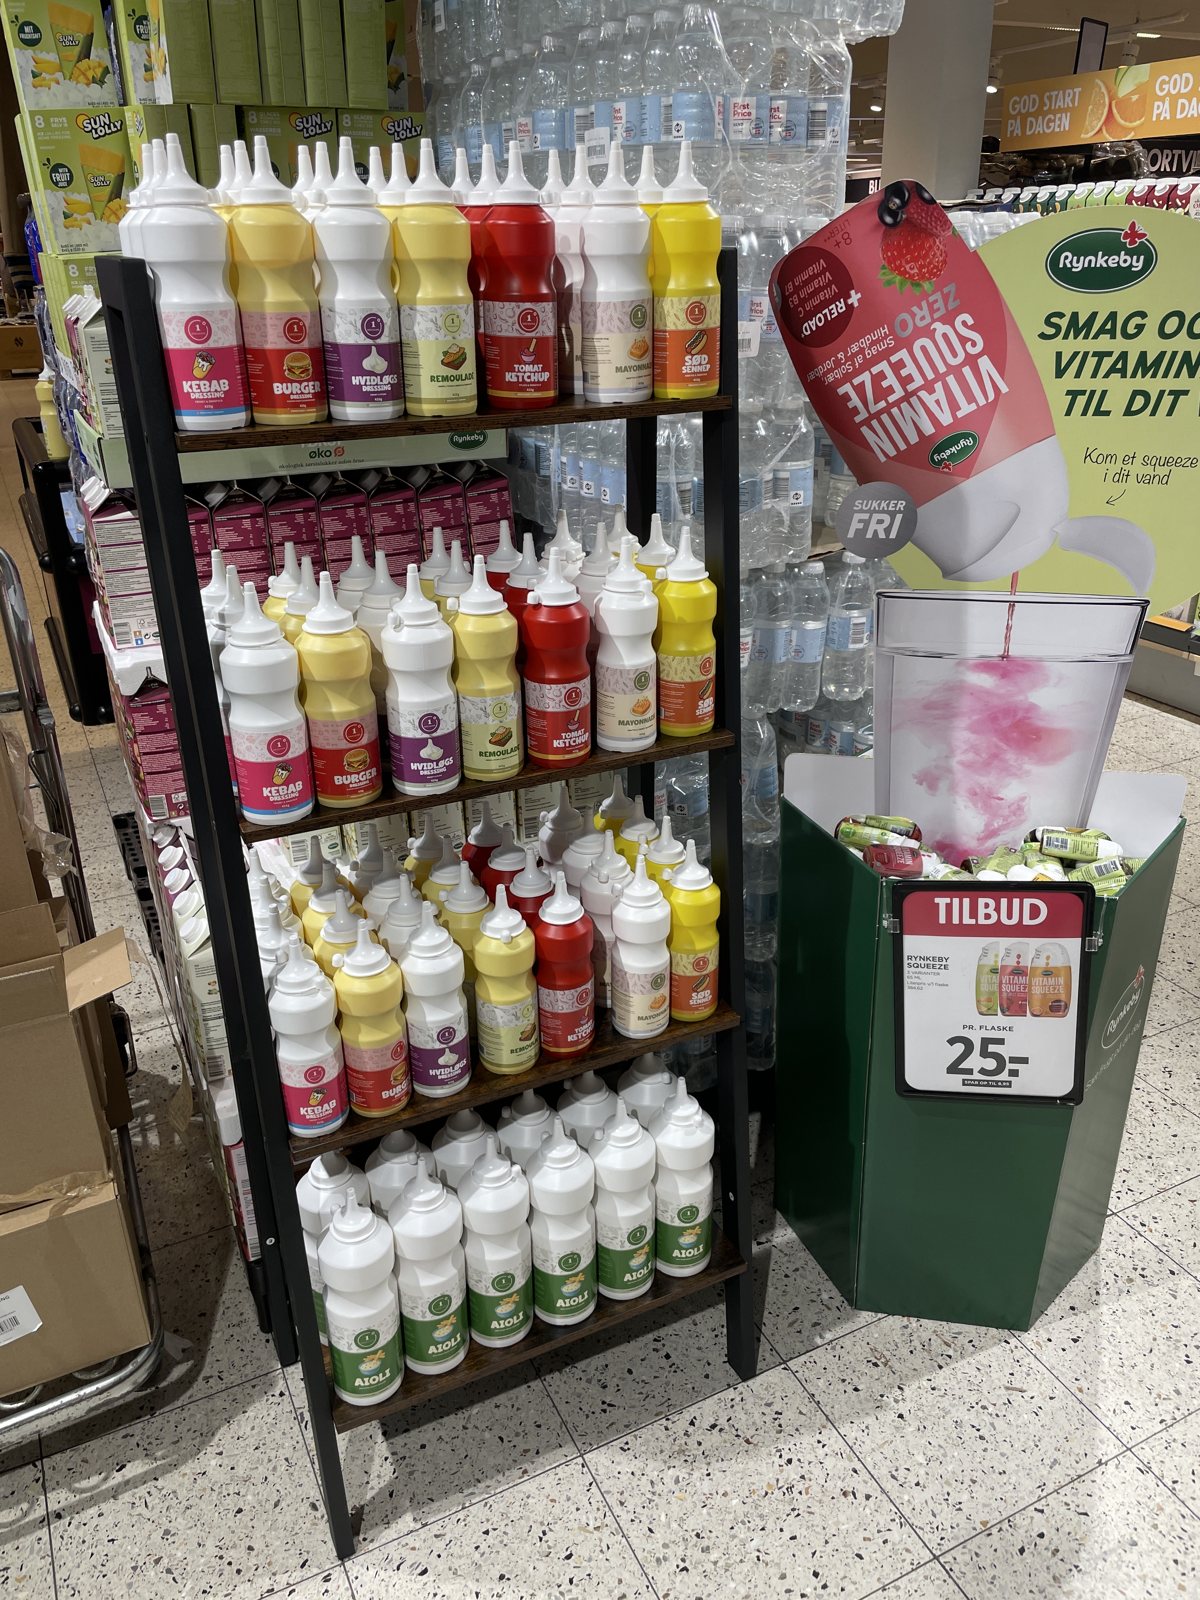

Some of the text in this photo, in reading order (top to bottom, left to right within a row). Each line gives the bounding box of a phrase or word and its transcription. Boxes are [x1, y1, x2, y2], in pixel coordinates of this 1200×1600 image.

[59, 34, 74, 42] SUN
[1155, 72, 1194, 97] GOD
[1009, 87, 1082, 116] GOD START
[1152, 98, 1171, 122] PÅ
[35, 115, 45, 128] 8
[83, 113, 110, 132] SUN
[249, 111, 257, 124] 8
[296, 113, 321, 131] SUN
[343, 114, 351, 127] 8
[387, 117, 412, 134] SUN
[1007, 113, 1071, 138] PÅ DAGEN
[92, 120, 122, 139] LOLLY
[303, 121, 333, 138] LOLLY
[394, 125, 422, 141] LOLLY
[52, 173, 71, 182] FRUIT
[1058, 251, 1145, 272] Rynkeby
[69, 264, 79, 277] 8
[784, 258, 827, 295] Vitamin B7
[787, 271, 833, 308] Vitamin B3
[797, 284, 839, 318] Vitamin C
[893, 282, 961, 338] ZERO
[1037, 310, 1149, 341] SMAG
[684, 354, 709, 366] SØD
[806, 324, 890, 382] Hindbær & Jordbær
[821, 335, 895, 386] Smag af Solbær,
[513, 364, 543, 372] TOMAT
[682, 364, 711, 374] SENNEP
[837, 312, 984, 424] SQUEEZE
[352, 374, 398, 385] HVIDLØGS
[505, 372, 550, 382] KETCHUP
[182, 380, 230, 393] KEBAB
[273, 381, 321, 395] BURGER
[362, 384, 392, 392] DRESSING
[190, 391, 225, 400] DRESSING
[1064, 389, 1190, 417] TIL DIT
[860, 355, 1010, 464] VITAMIN
[453, 433, 484, 444] Rynkeby
[308, 447, 332, 459] øko
[933, 437, 974, 462] Rynkeby
[1083, 447, 1199, 473] Kom et squeeze
[1103, 467, 1172, 486] i dit vand
[853, 500, 907, 511] SUKKER
[847, 513, 903, 539] FRI
[561, 728, 586, 739] TOMAT
[410, 757, 454, 771] HVIDLØGS
[334, 768, 378, 786] BURGER
[262, 781, 303, 798] KEBAB
[934, 897, 1048, 926] TILBUD
[906, 954, 950, 963] RYNKEBY
[906, 962, 950, 970] SQUEEZE
[1001, 976, 1028, 984] VITAMI
[1001, 984, 1028, 992] SQUEEZ
[1031, 977, 1064, 985] VITAMIN
[691, 989, 711, 1000] SØD
[1031, 985, 1065, 994] SQUEEZE
[429, 1058, 467, 1076] HVIDLØGS
[300, 1099, 337, 1116] KEBAB
[672, 1244, 704, 1258] AIOLI
[623, 1261, 652, 1283] AIOLI
[556, 1290, 589, 1308] AIOLI
[490, 1311, 525, 1329] AIOLI
[428, 1332, 461, 1355] AIOLI
[354, 1368, 391, 1387] AIOLI
